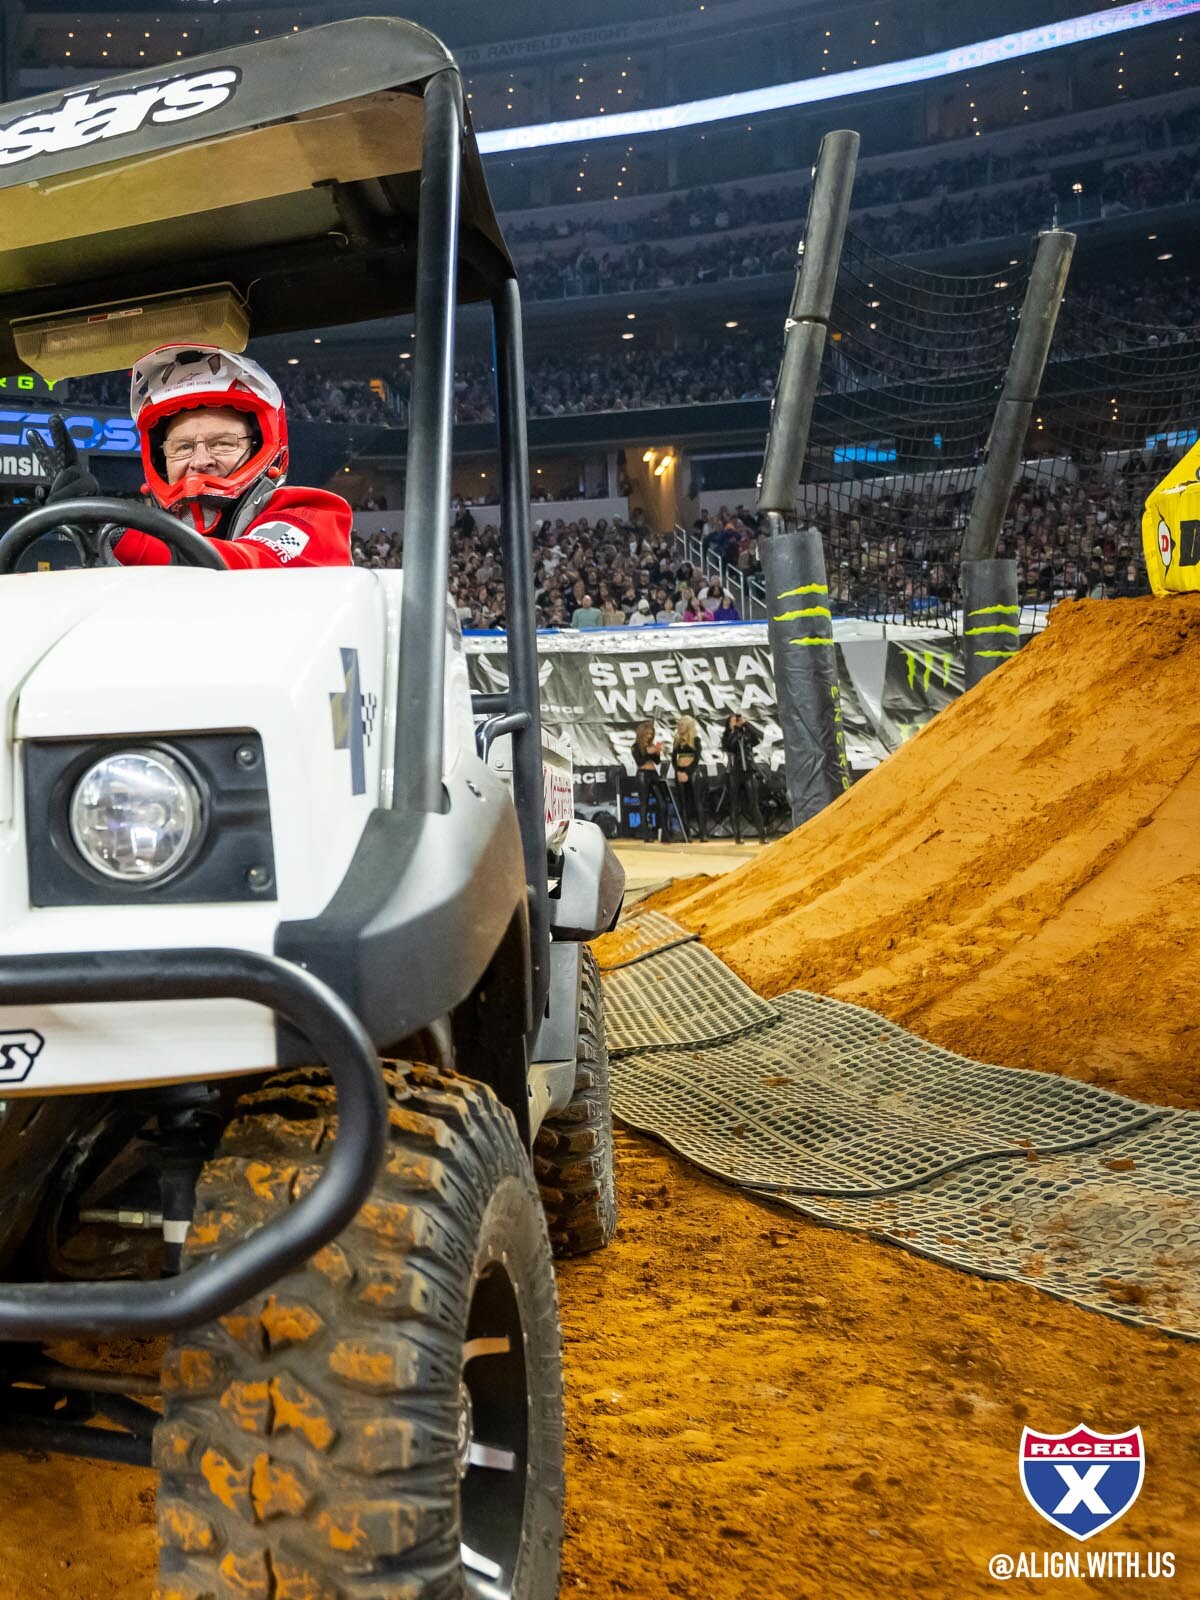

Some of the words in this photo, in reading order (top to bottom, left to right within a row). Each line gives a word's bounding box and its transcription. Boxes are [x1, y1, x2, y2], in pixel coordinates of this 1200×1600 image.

[588, 654, 774, 687] SPECIA
[539, 703, 585, 715] ORCE
[593, 683, 776, 714] WARFA
[830, 685, 852, 791] ENERG
[572, 771, 607, 785] RCE
